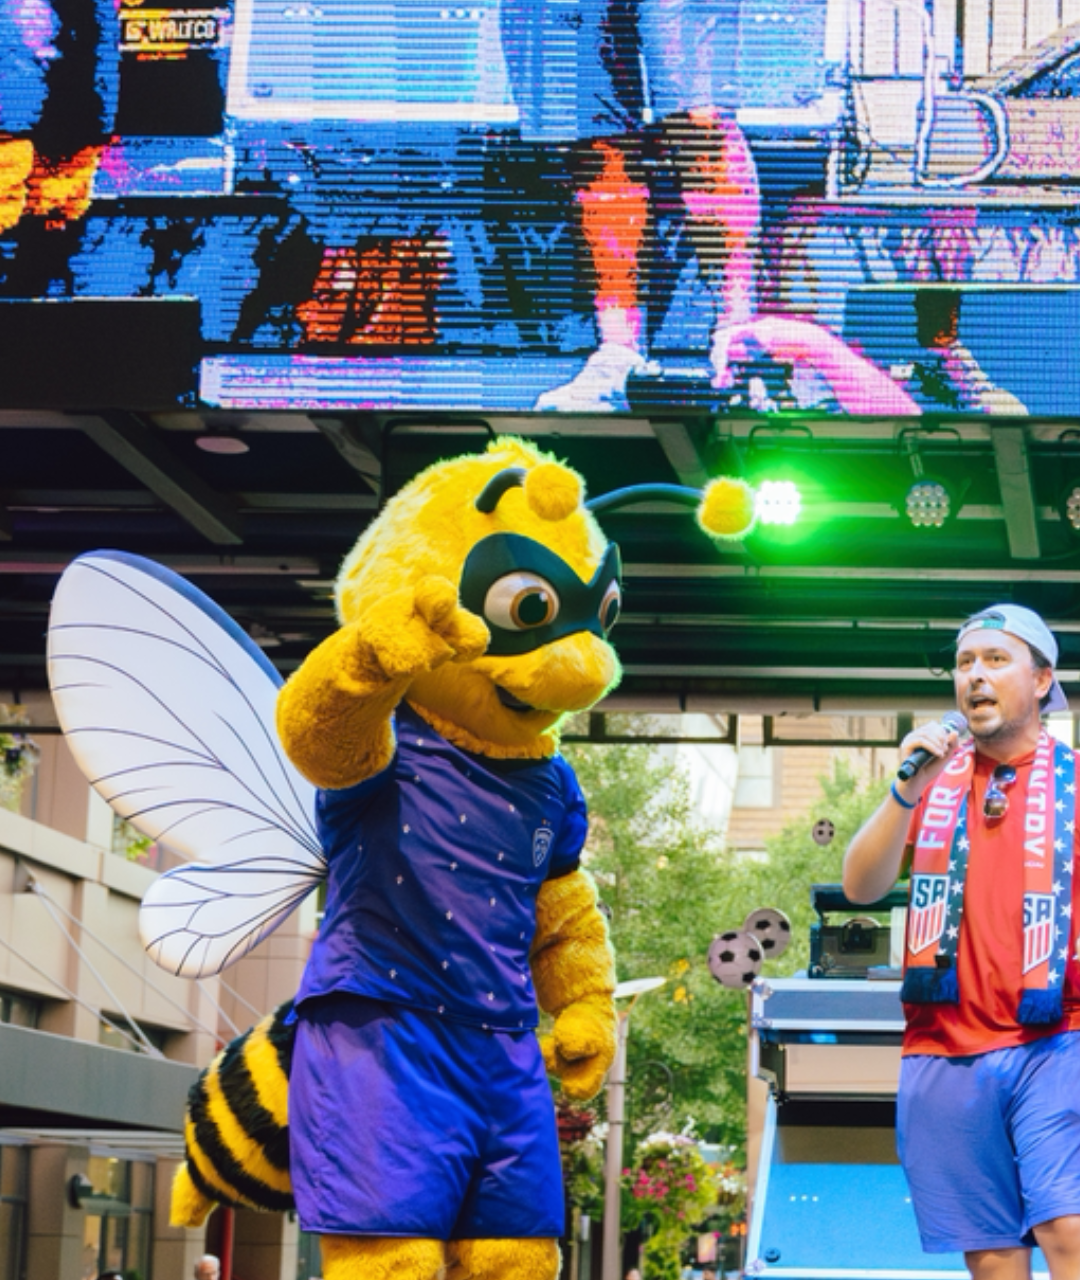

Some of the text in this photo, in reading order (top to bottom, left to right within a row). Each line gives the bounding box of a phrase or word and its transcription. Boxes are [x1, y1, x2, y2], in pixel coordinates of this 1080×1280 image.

[916, 785, 963, 849] FOR
[915, 878, 947, 909] SA
[1023, 897, 1052, 928] SA
